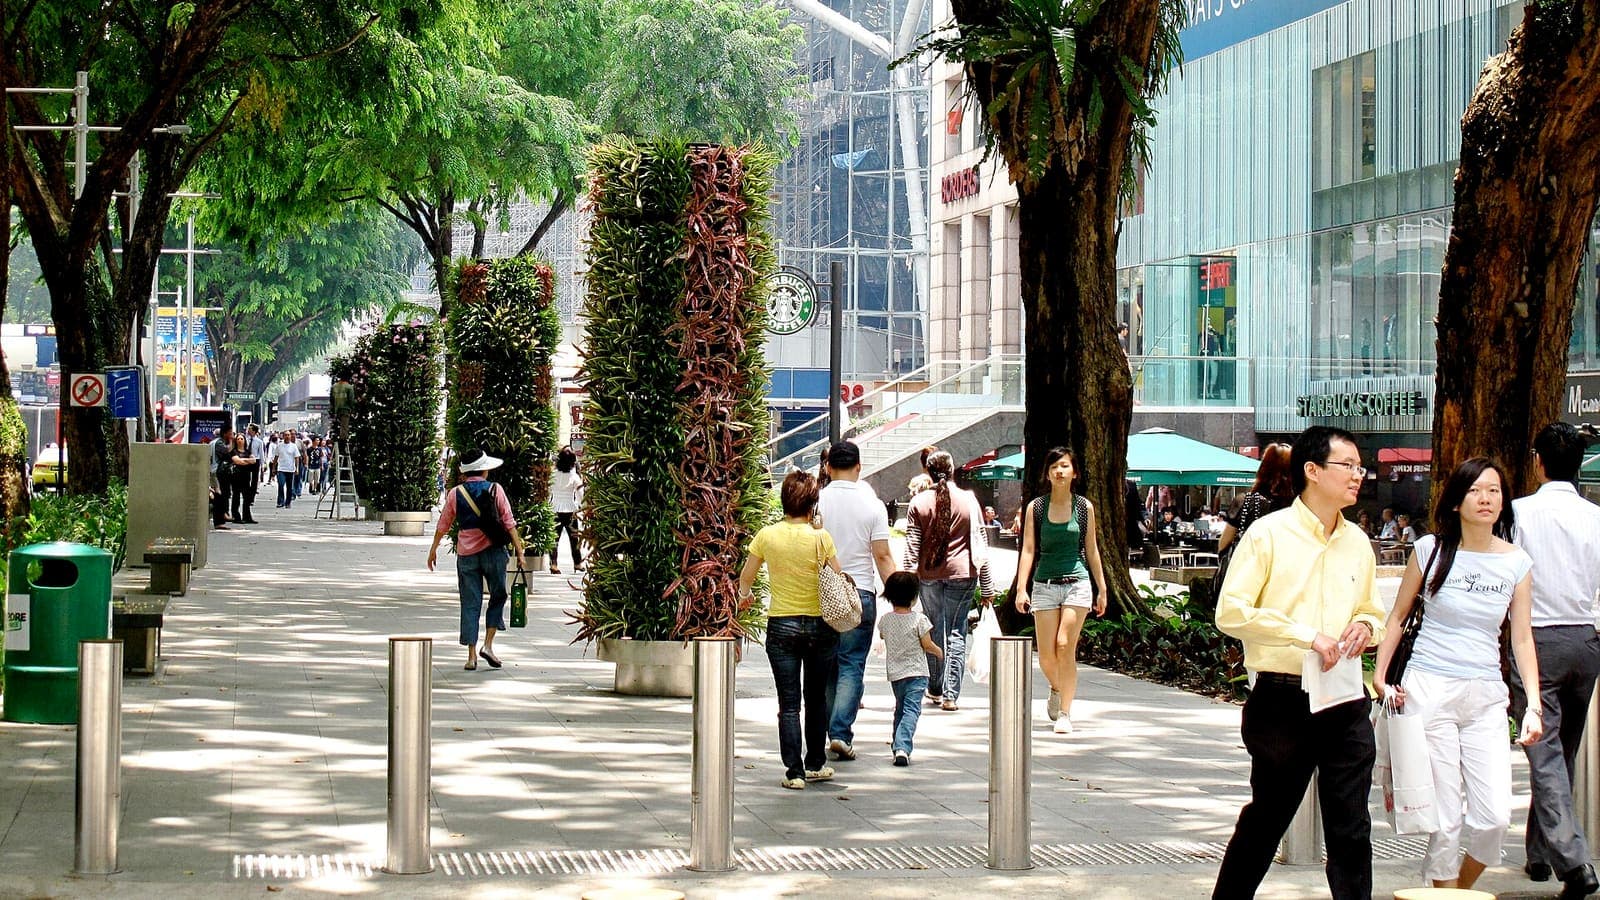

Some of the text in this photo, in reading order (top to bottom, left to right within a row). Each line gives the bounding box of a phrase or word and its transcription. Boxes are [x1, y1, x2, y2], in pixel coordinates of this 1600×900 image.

[942, 167, 980, 204] BORDERS
[766, 317, 806, 331] OFFEE
[1296, 391, 1417, 417] STARBUCKS COFFEE
